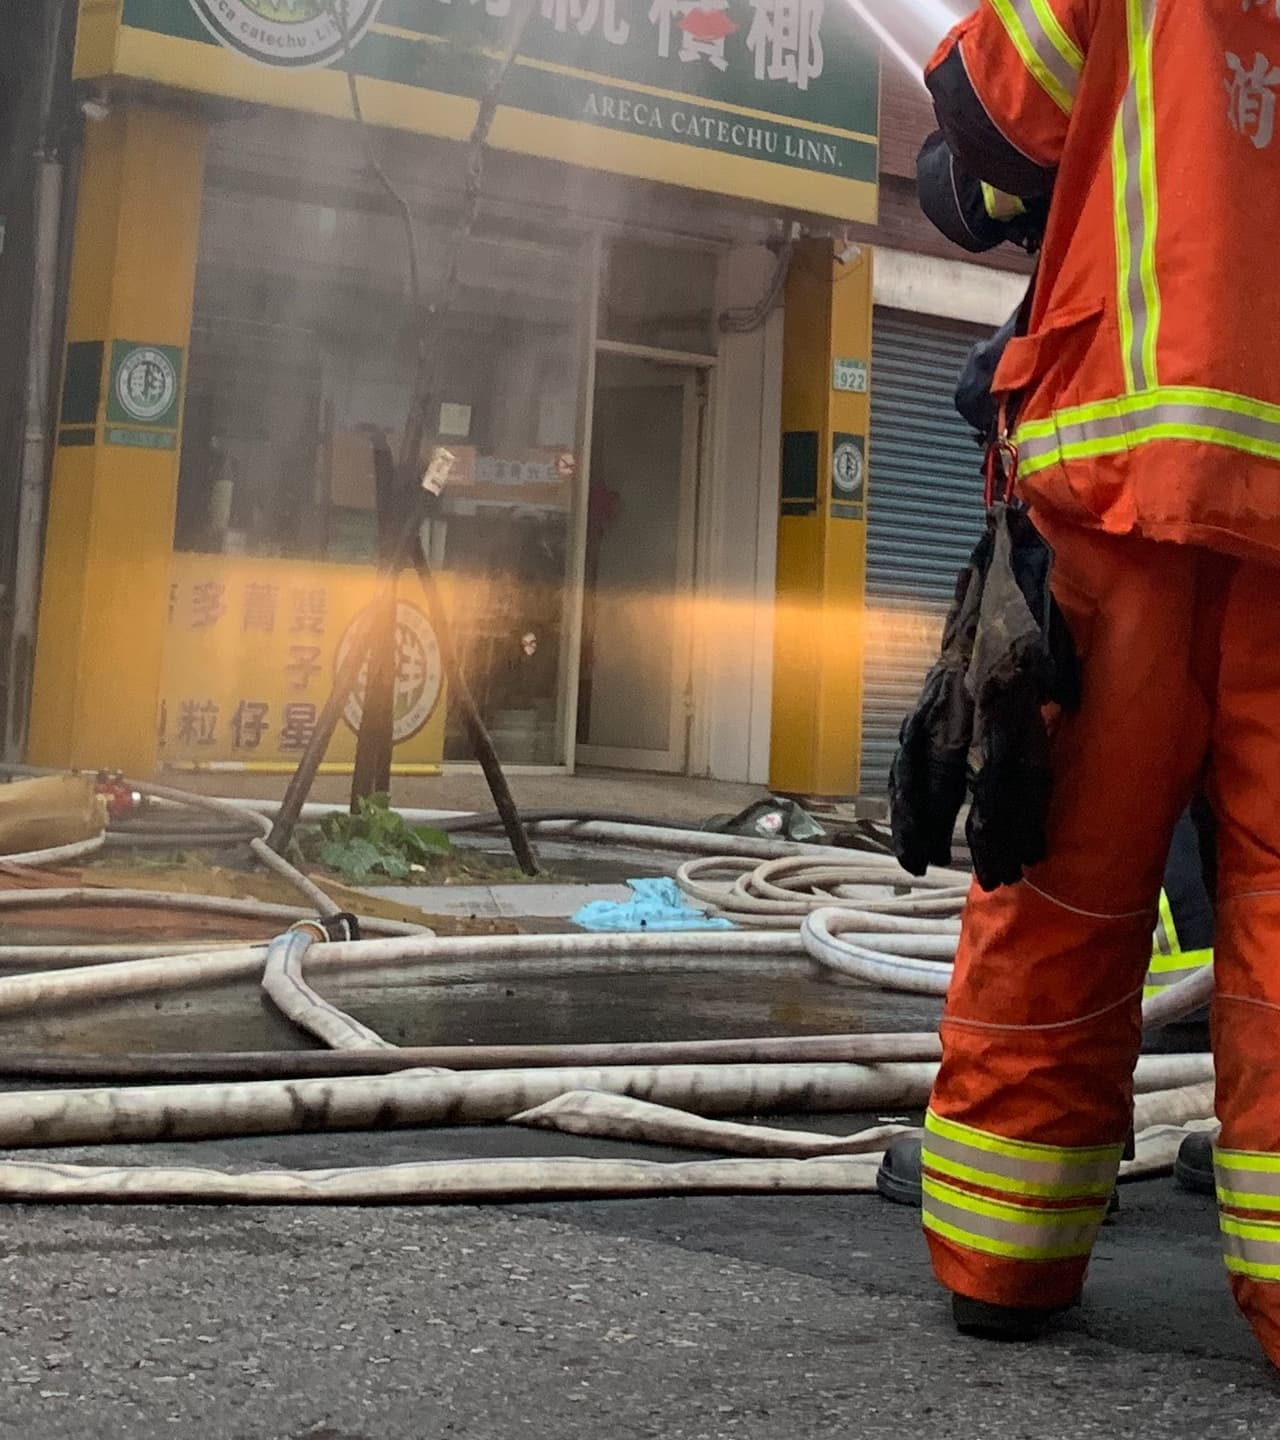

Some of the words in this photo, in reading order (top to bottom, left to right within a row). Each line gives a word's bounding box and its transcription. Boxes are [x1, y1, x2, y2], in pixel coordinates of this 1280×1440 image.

[582, 92, 664, 129] ARECA
[671, 111, 778, 153] CATECHU
[785, 135, 843, 167] LINN.
